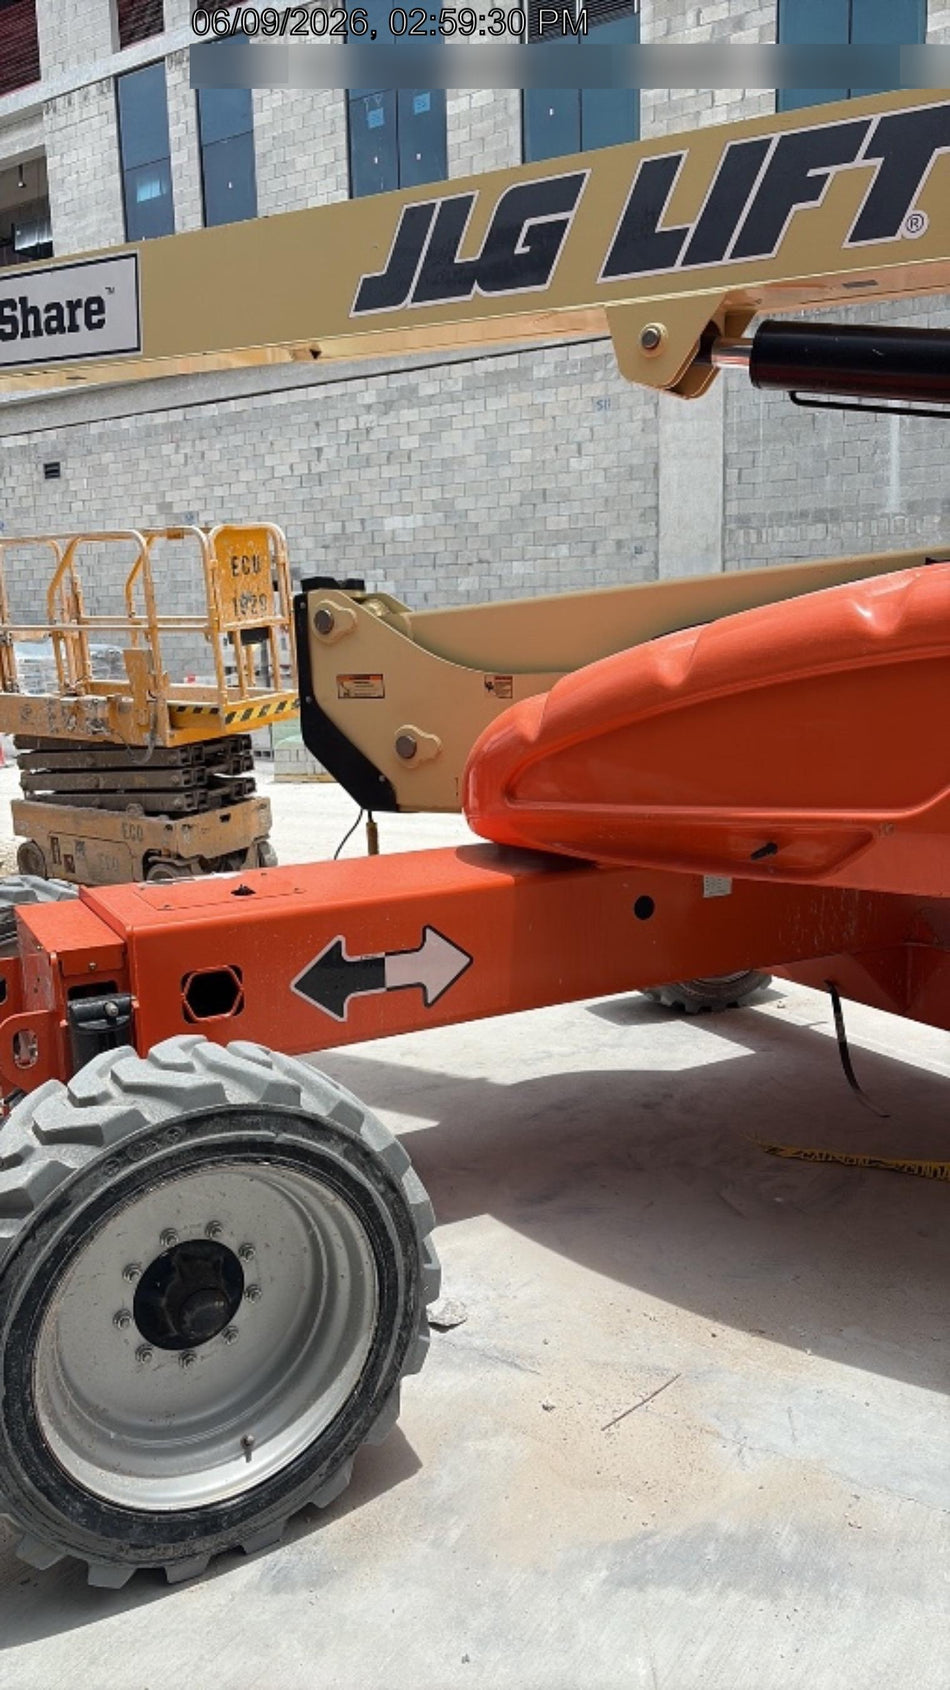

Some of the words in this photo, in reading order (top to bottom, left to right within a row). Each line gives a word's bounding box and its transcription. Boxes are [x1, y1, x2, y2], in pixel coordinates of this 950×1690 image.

[350, 169, 591, 318] JLG
[597, 99, 950, 284] LIFT
[0, 296, 106, 341] Share
